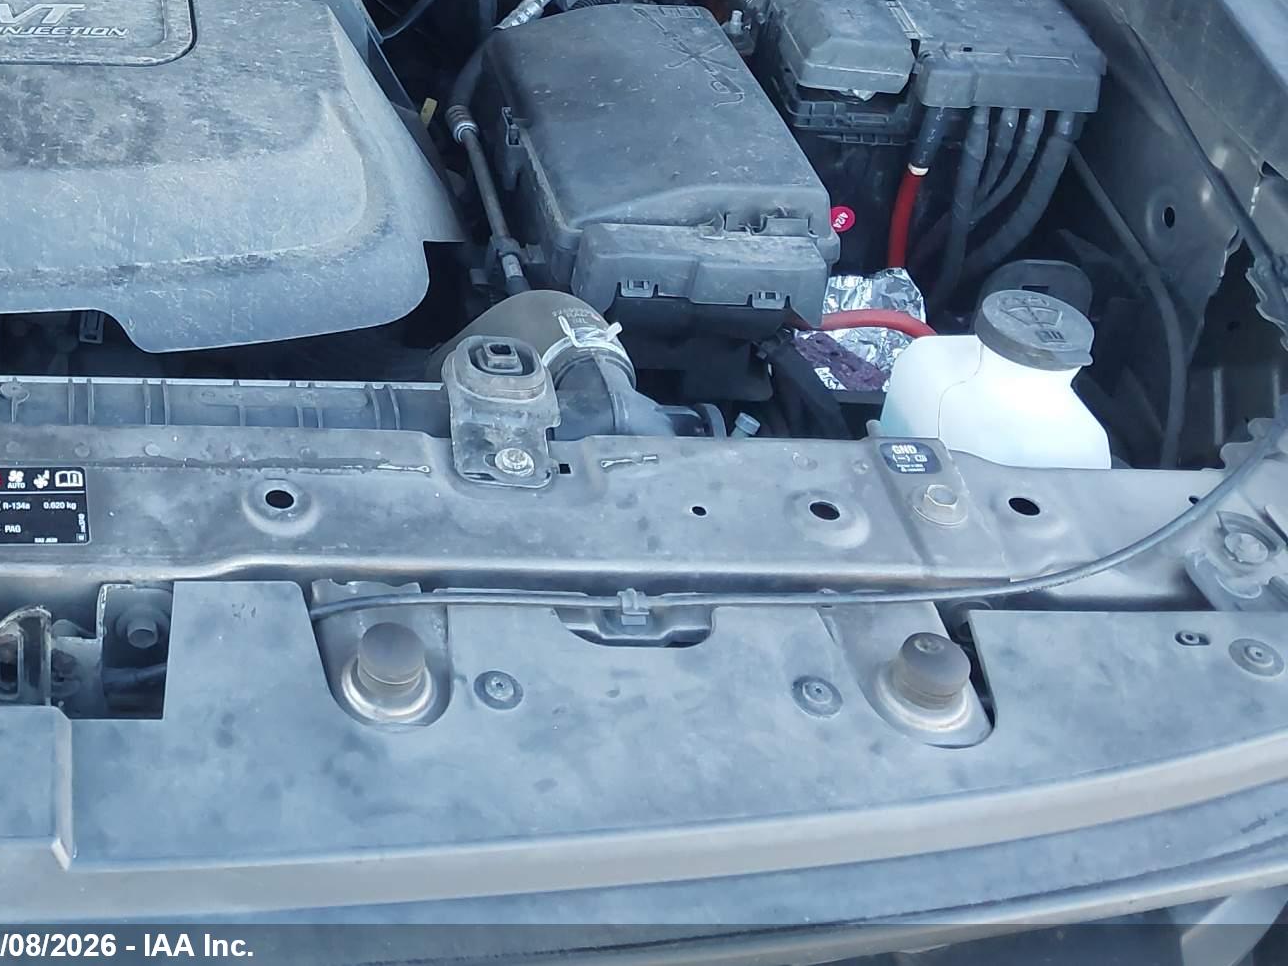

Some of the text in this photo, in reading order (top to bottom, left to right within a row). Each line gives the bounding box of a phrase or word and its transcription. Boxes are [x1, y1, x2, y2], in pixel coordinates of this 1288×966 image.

[892, 444, 918, 454] GND
[3, 502, 30, 510] R-134a
[66, 502, 77, 510] kg
